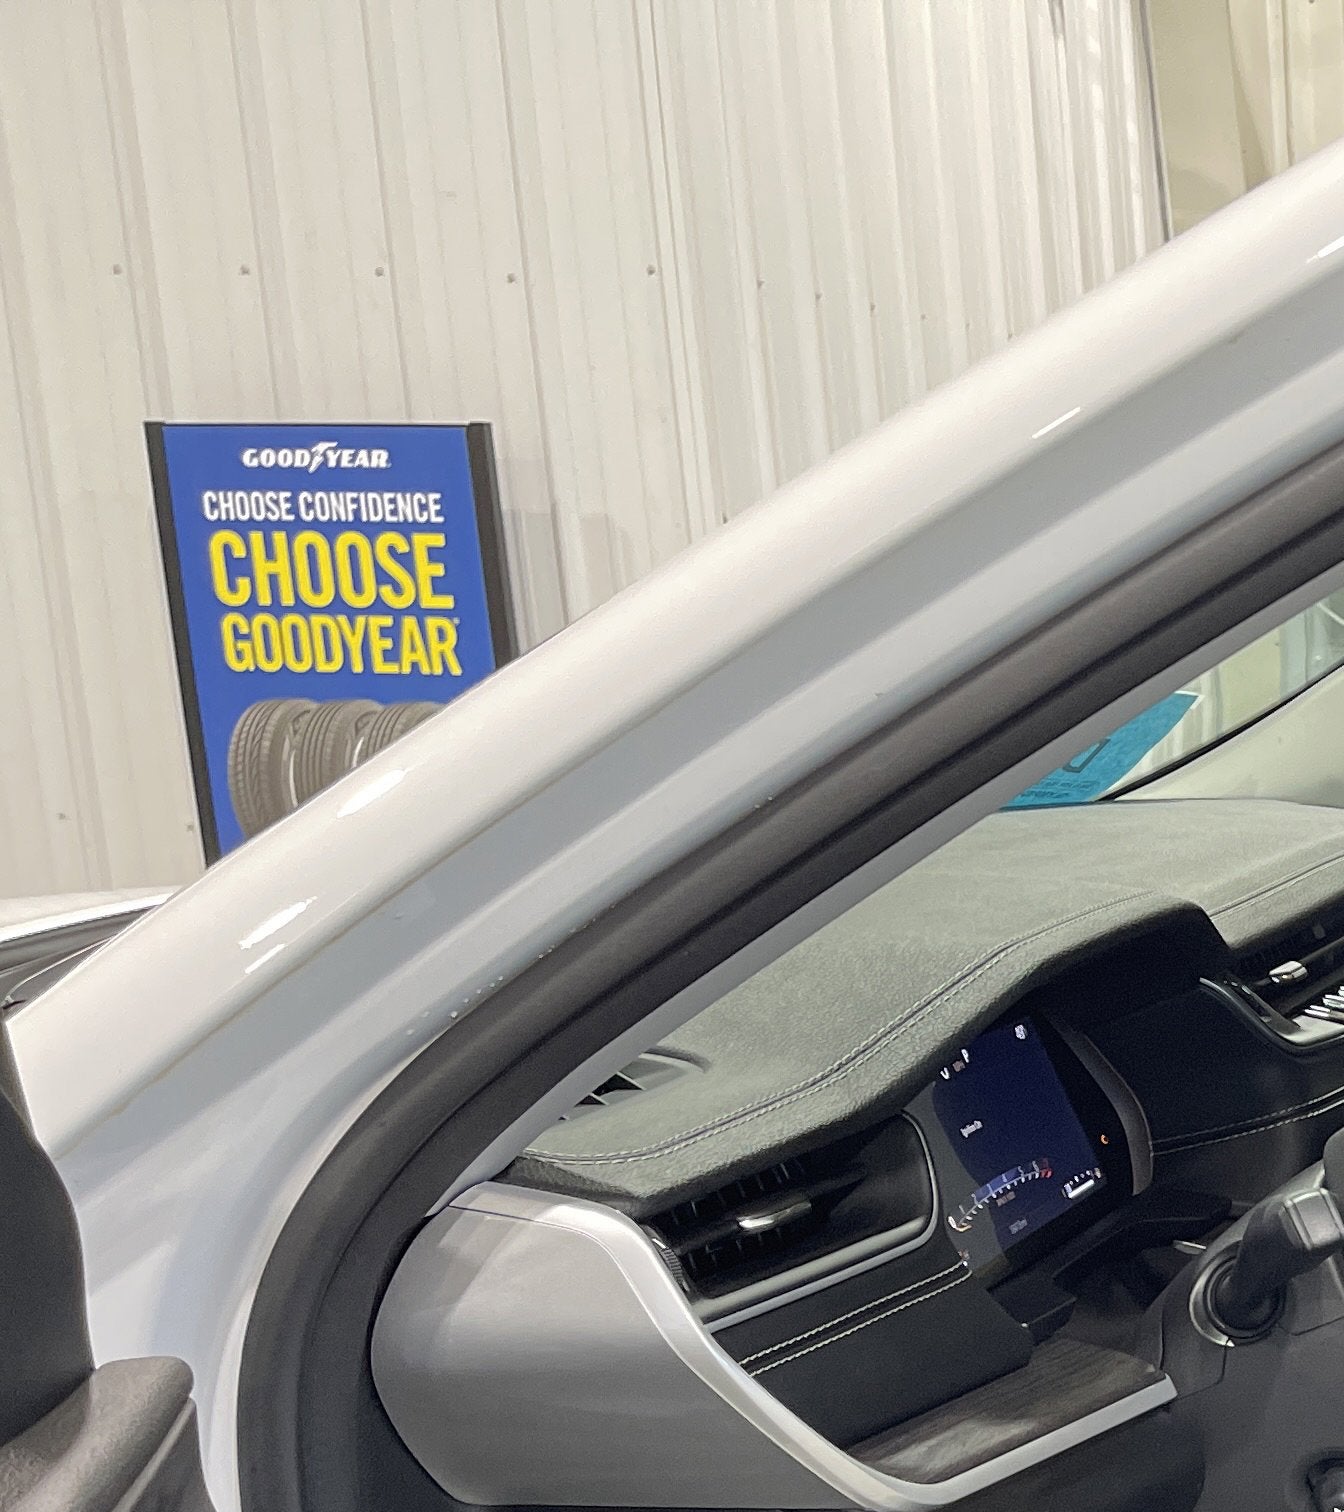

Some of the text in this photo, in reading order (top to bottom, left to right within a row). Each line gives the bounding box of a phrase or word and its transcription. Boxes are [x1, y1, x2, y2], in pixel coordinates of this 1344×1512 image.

[242, 441, 391, 472] GOODYEAR
[203, 491, 445, 523] CHOOSE CONFIDENCE
[208, 529, 455, 609] CHOOSE
[221, 612, 463, 676] GOODYEAR
